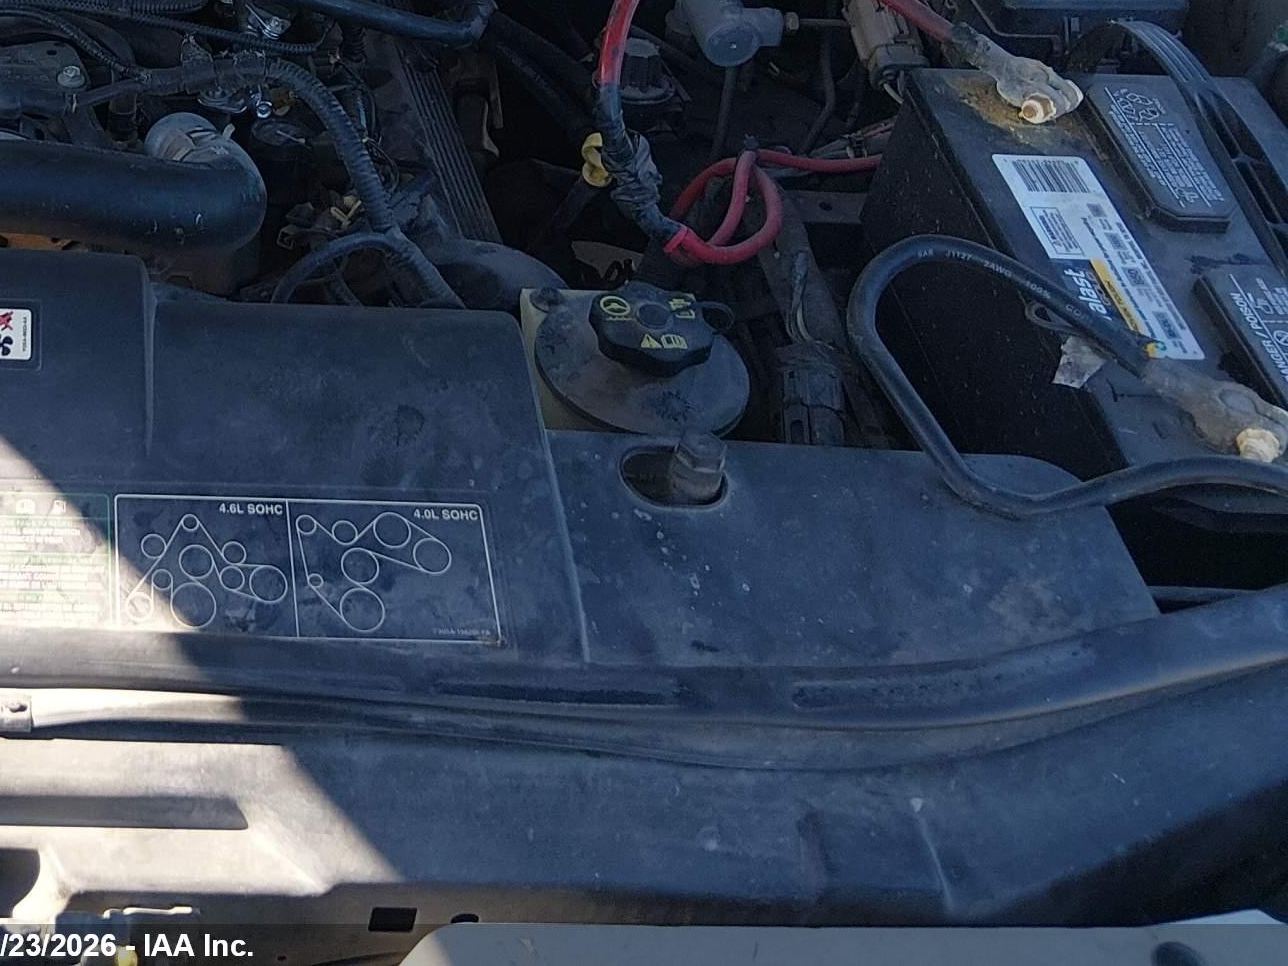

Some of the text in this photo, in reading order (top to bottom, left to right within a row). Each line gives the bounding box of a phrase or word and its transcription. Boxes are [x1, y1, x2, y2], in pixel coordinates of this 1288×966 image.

[1230, 292, 1263, 330] POISON
[218, 502, 284, 515] 4.6L SOHC
[413, 507, 479, 521] 4.0L SOHC
